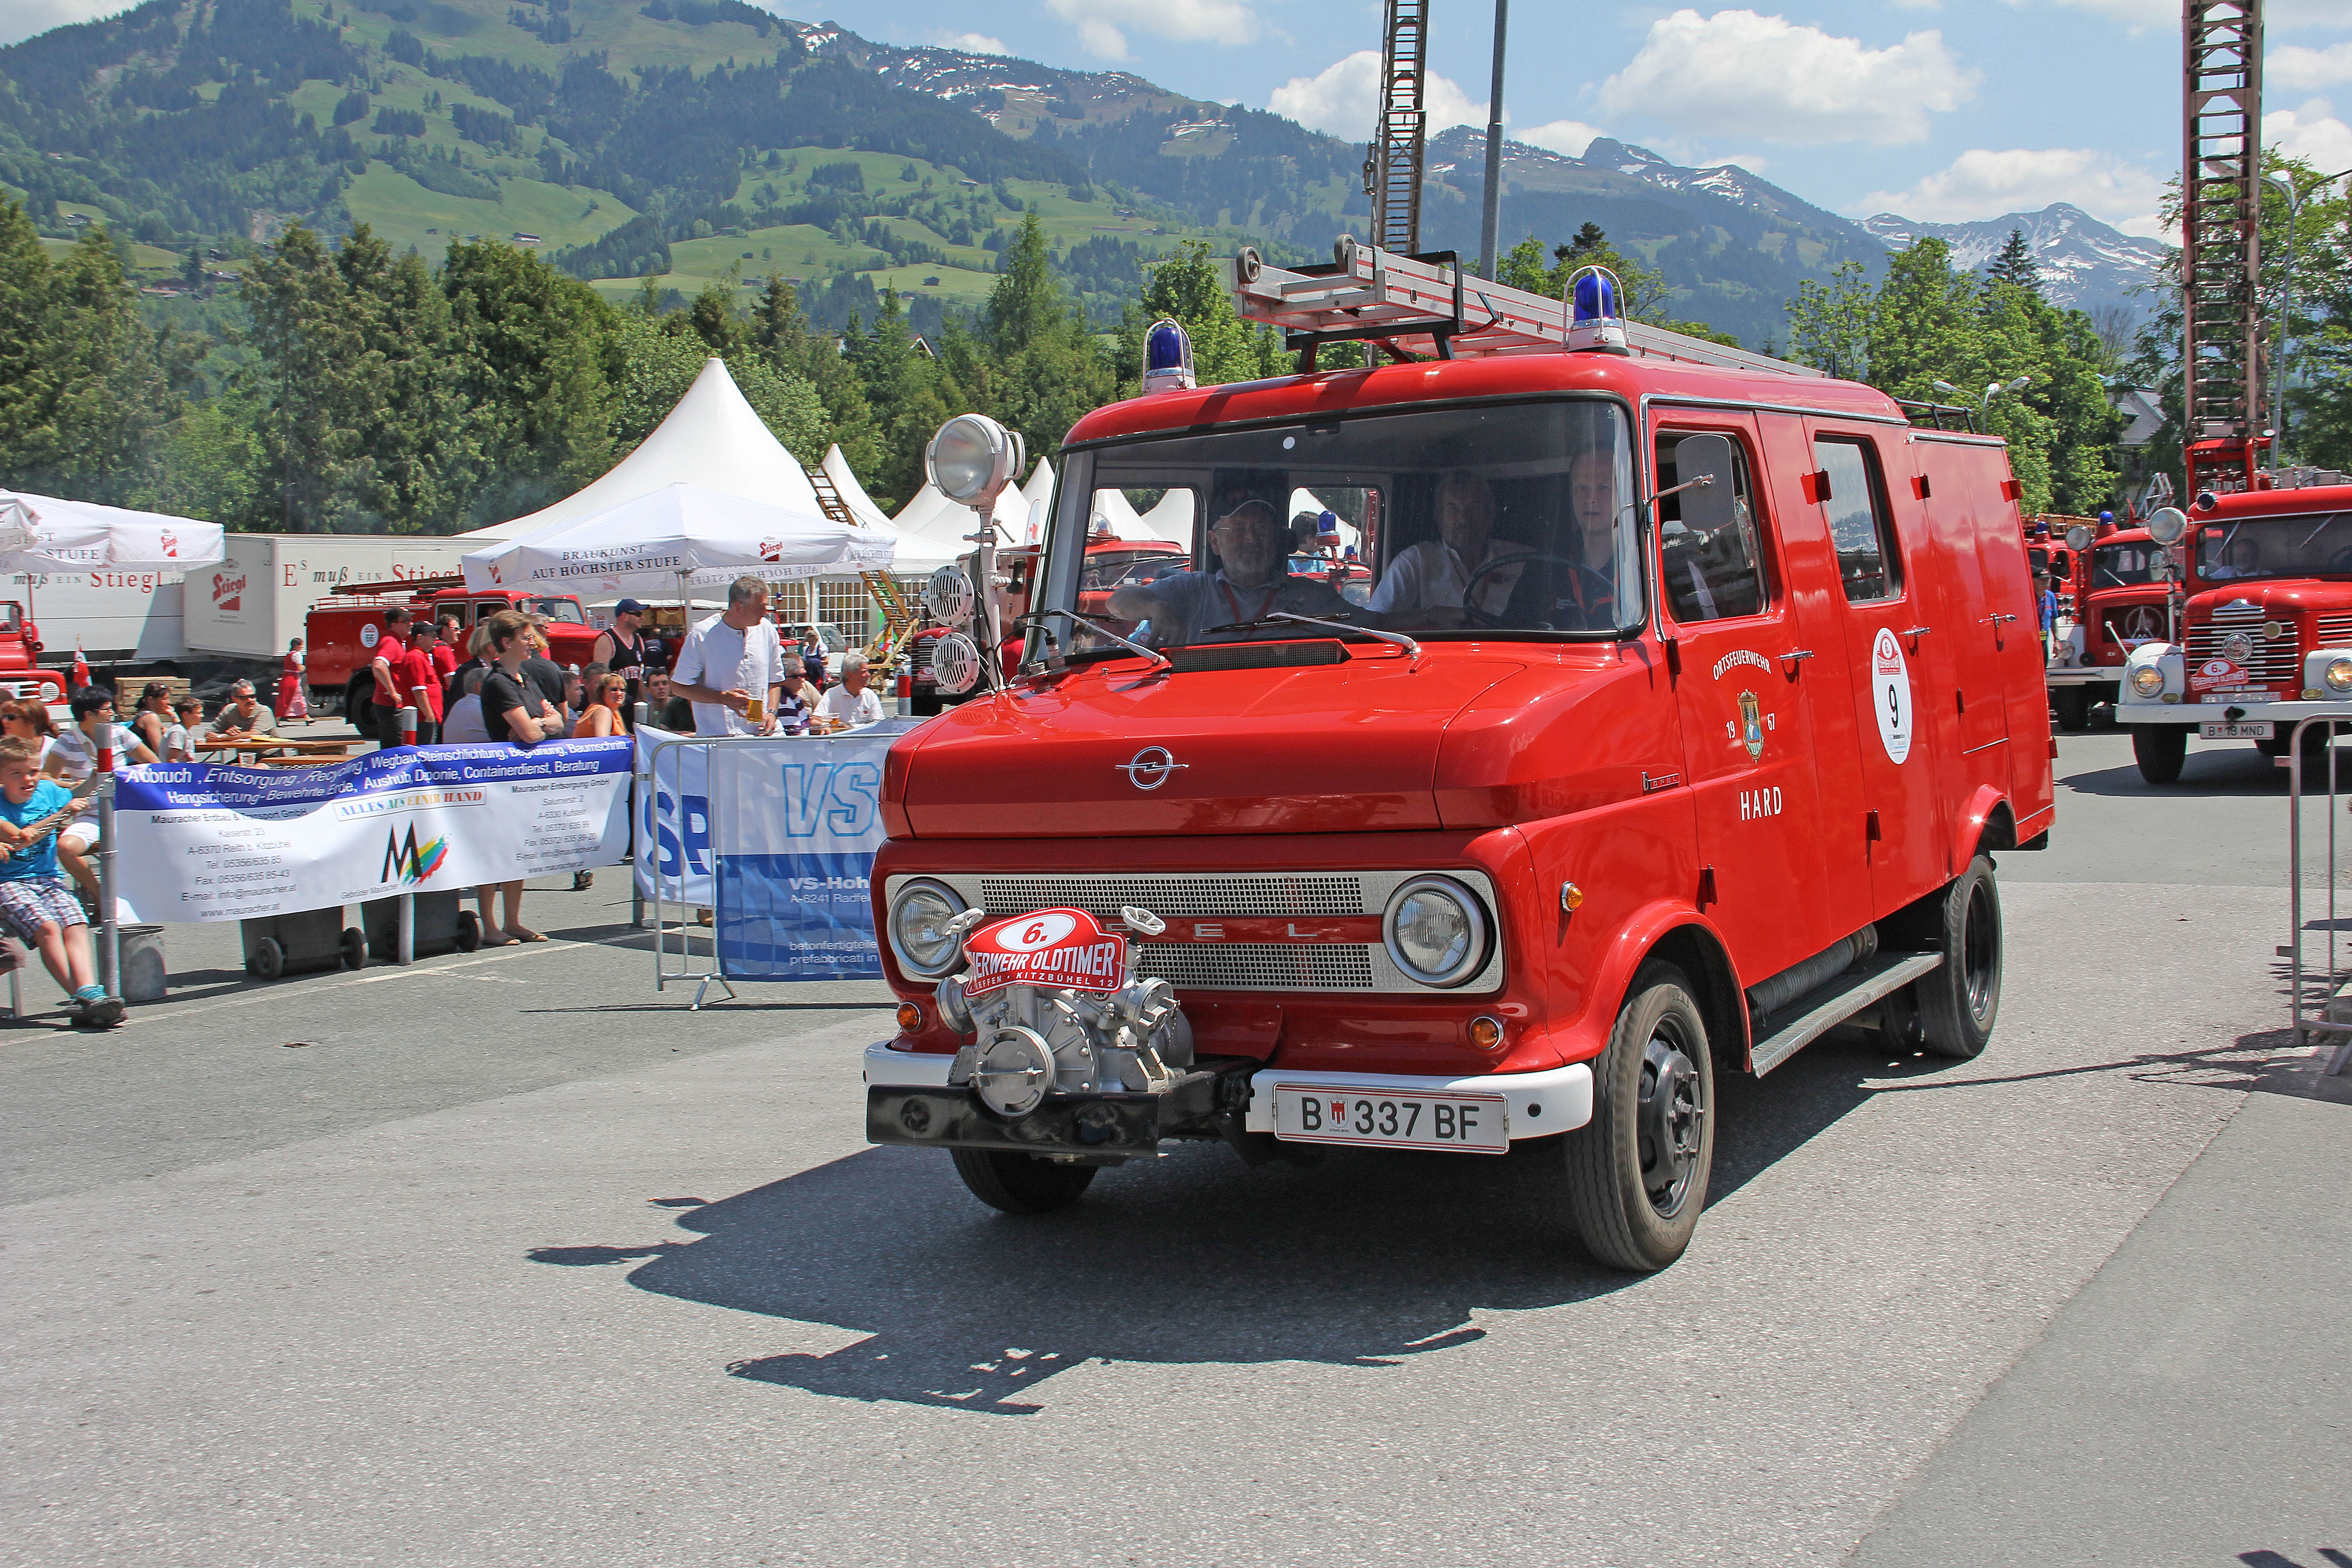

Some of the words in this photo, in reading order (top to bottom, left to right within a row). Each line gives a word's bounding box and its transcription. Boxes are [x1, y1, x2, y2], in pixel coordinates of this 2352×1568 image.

[563, 544, 646, 560] BRAUKUNST
[760, 541, 784, 557] Stiegl
[313, 566, 349, 586] muß
[358, 572, 382, 581] EIN
[532, 568, 556, 579] AUF
[560, 560, 633, 577] HÖCHSTER
[637, 556, 681, 569] STUFE
[91, 571, 162, 593] Stiegl
[213, 573, 247, 602] Stiegl
[1713, 649, 1772, 681] ORTSFEUERWEHR
[2211, 664, 2222, 673] 6.
[1887, 683, 1899, 728] 9
[1725, 720, 1736, 740] 19
[1766, 712, 1776, 731] 67
[2208, 726, 2215, 736] B
[2240, 726, 2264, 736] MND
[124, 767, 192, 784] Abbruch
[464, 762, 552, 779] Containerdienst,
[554, 760, 600, 773] Beratung
[512, 784, 550, 794] Mauracher
[550, 780, 589, 791] Entsorgung
[590, 778, 610, 787] GmbH
[341, 800, 385, 816] ALLES
[444, 791, 482, 803] HAND
[579, 794, 584, 803] 2
[782, 762, 880, 838] VS
[1740, 785, 1783, 821] HARD
[151, 813, 202, 823] Mauracher
[281, 808, 308, 818] GmbH
[254, 827, 266, 836] 23
[187, 844, 221, 855] A-6370
[206, 860, 222, 869] Tel.
[195, 876, 216, 885] Fax.
[218, 883, 297, 900] info@mauracher.at
[790, 894, 830, 903] A-6241
[200, 902, 280, 917] www.mauracher.at
[1022, 922, 1048, 944] 6.
[789, 954, 864, 966] prefabbricati
[867, 953, 878, 962] in
[1030, 942, 1116, 977] OLDTIMER
[1016, 971, 1091, 985] KITZBÜHEL
[1301, 1096, 1322, 1131] B
[1354, 1100, 1422, 1137] 337
[1434, 1104, 1480, 1140] BF
